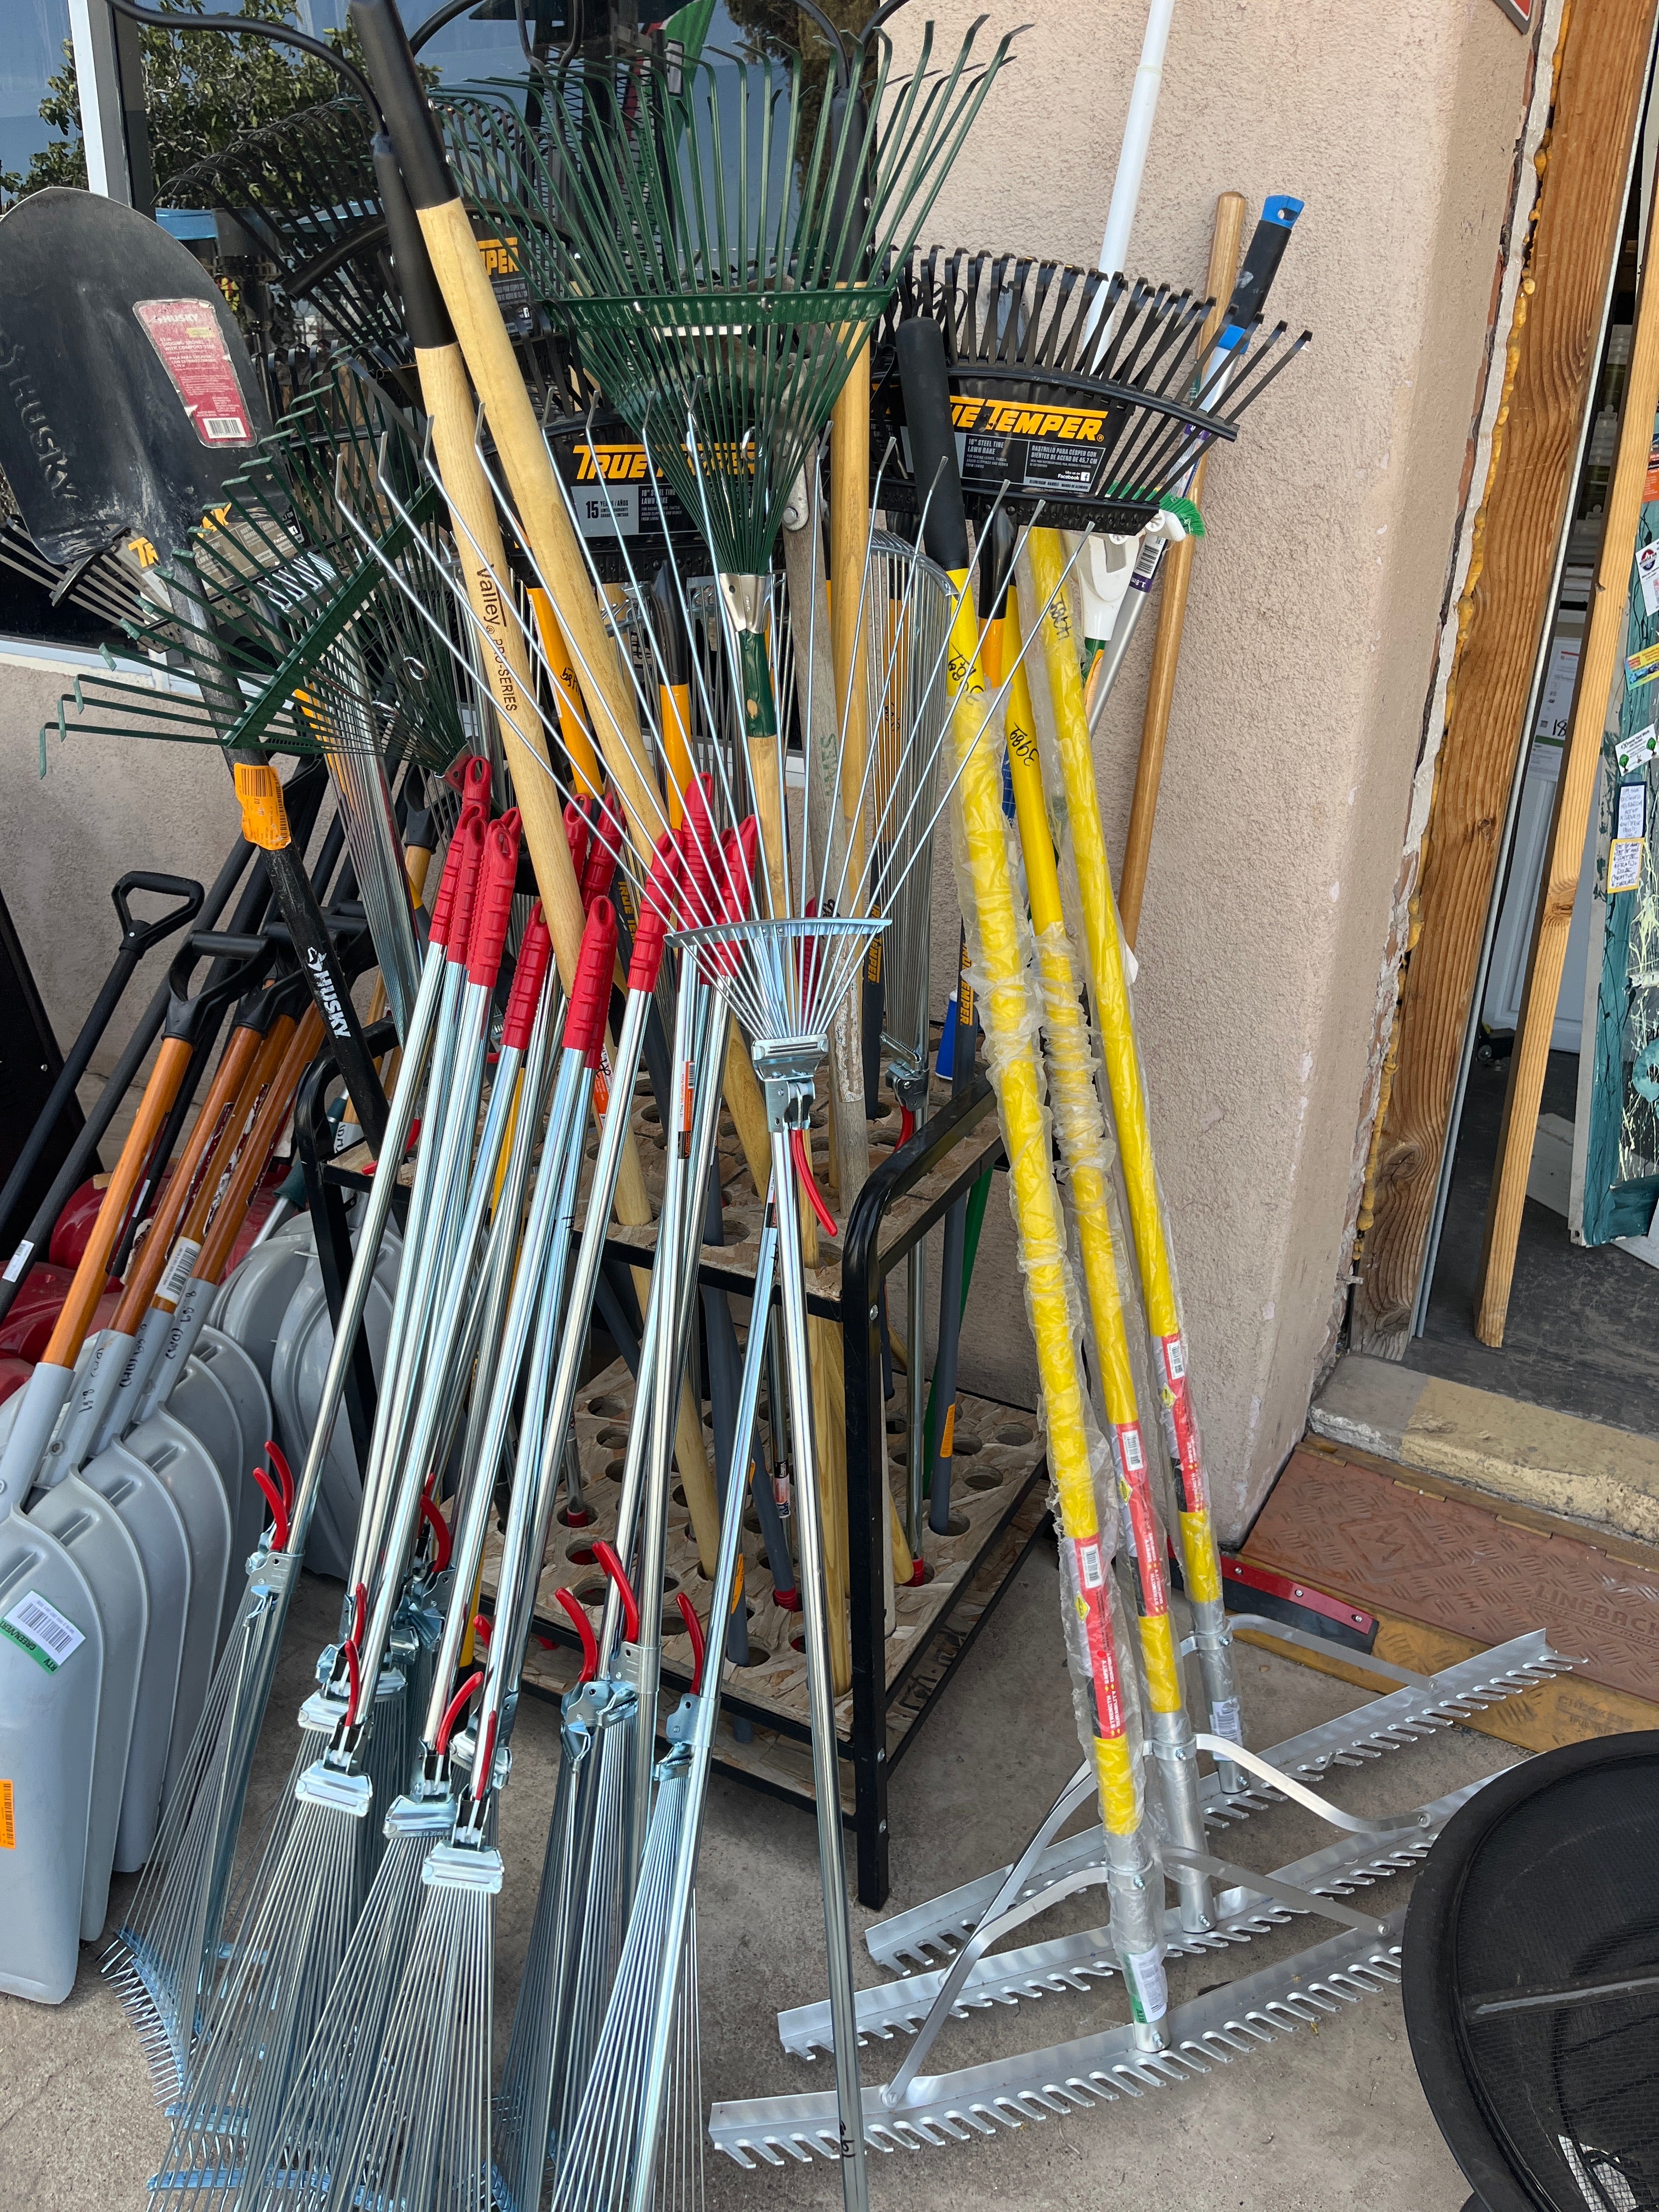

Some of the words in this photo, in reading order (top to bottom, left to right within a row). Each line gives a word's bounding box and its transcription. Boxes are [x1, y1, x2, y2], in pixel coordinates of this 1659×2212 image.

[163, 313, 198, 323] HUSKY
[984, 399, 1109, 442] TEMPER
[9, 375, 83, 500] HUSKY
[967, 445, 981, 453] LAWN
[982, 447, 996, 455] RAKE
[994, 441, 1005, 449] TINE
[1031, 445, 1055, 453] RASTRILLO
[573, 444, 648, 479] TRUE
[1031, 451, 1049, 459] DIENTES
[586, 500, 599, 518] 15
[477, 564, 506, 628] Valley
[618, 881, 635, 915] TRUE
[313, 970, 351, 1037] HUSKY
[960, 979, 974, 1026] EMPER
[1144, 1539, 1153, 1564] SAFETY
[1150, 1572, 1159, 1606] STRENGTH
[0, 1621, 37, 1651] GREEN/VERT
[43, 1658, 58, 1672] RTV
[1101, 1660, 1109, 1684] SAFETY
[1106, 1695, 1115, 1729] STRENGTH
[1111, 1690, 1121, 1728] DURABILITY
[1136, 2008, 1146, 2023] RTV
